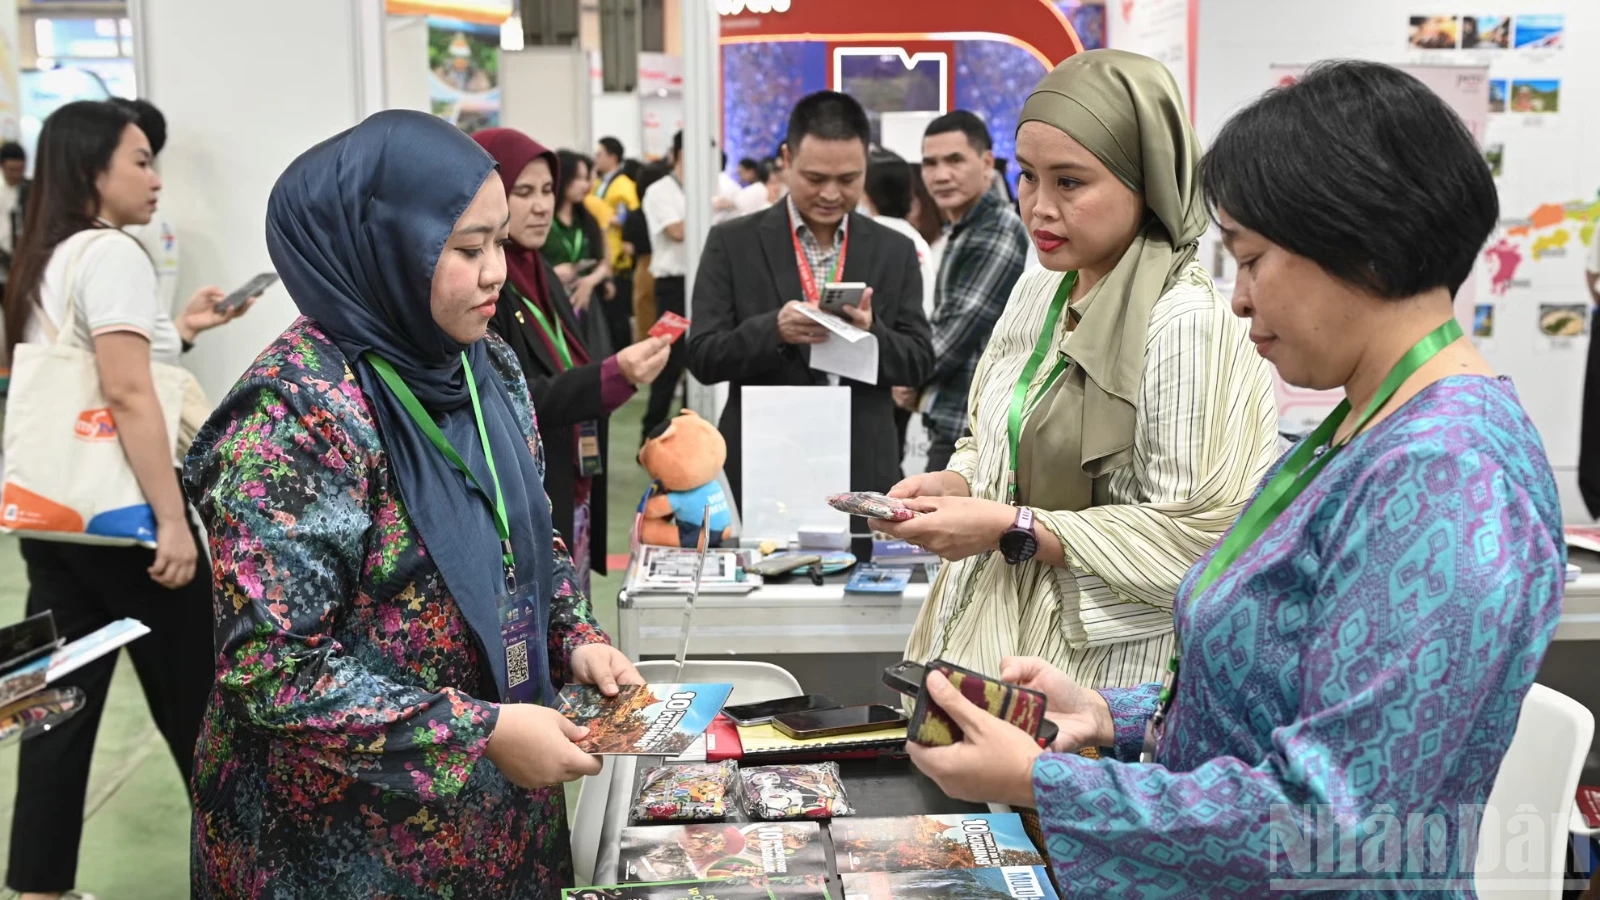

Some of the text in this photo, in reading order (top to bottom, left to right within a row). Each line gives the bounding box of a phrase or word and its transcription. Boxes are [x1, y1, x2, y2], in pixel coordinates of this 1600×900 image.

[665, 690, 697, 709] 10
[758, 827, 784, 839] 10
[962, 819, 990, 833] 10
[966, 833, 991, 865] KUCHING
[1007, 872, 1037, 896] MULU
